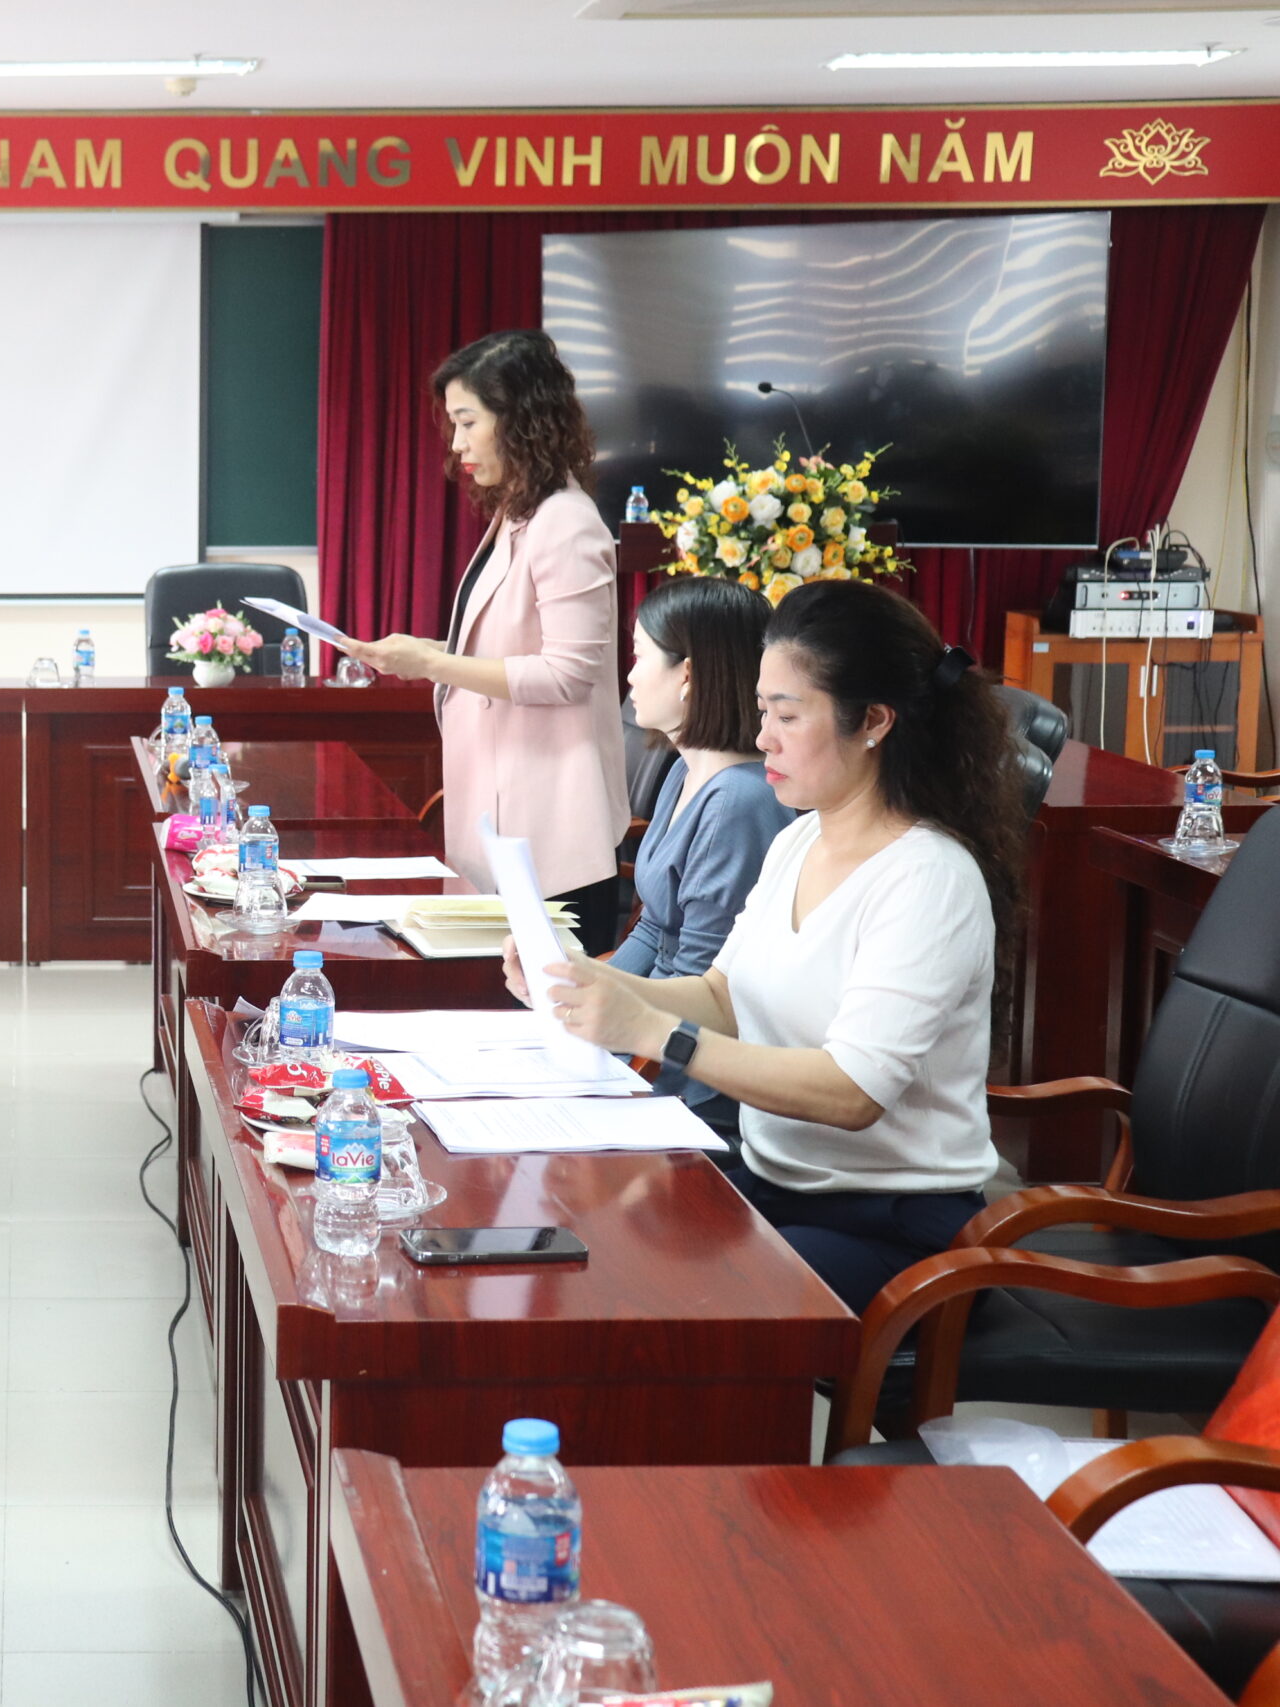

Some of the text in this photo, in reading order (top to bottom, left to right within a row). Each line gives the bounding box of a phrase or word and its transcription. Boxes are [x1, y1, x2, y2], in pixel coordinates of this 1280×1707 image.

[163, 136, 412, 192] QUANG
[444, 136, 604, 187] VINH
[639, 124, 841, 186] MUÔN
[879, 117, 1034, 185] NĂM
[331, 1150, 376, 1168] laVie
